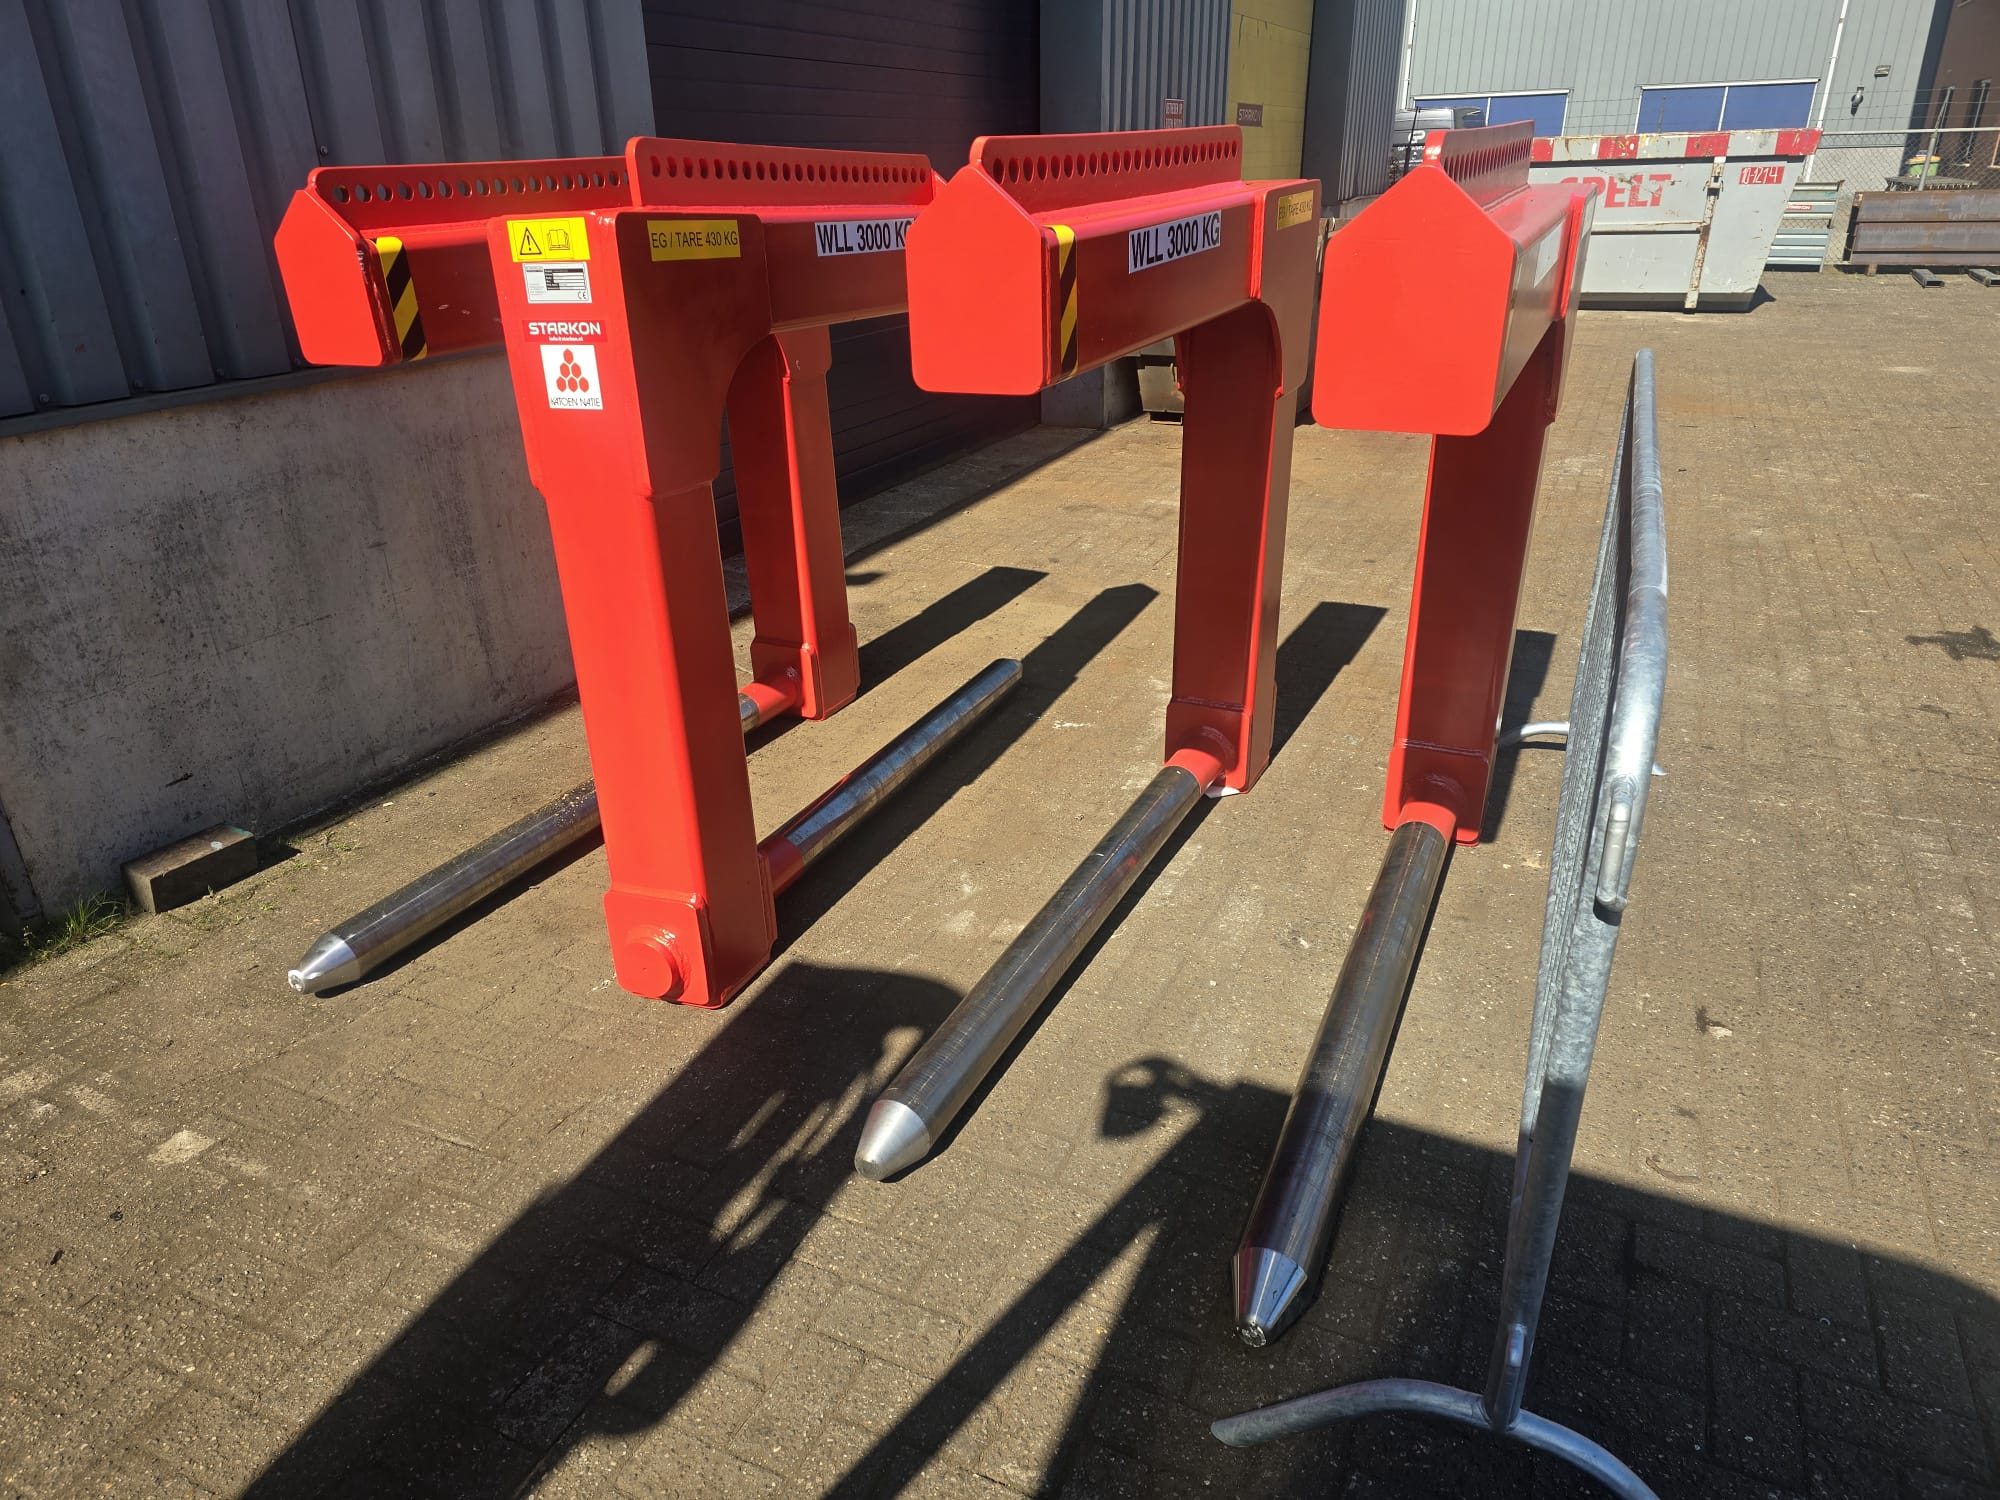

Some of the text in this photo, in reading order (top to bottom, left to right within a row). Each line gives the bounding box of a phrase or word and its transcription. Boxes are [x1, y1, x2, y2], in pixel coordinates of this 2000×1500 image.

[1560, 174, 1672, 208] PELT
[651, 232, 667, 248] EG
[676, 232, 703, 248] TARE
[705, 231, 721, 246] 430
[724, 230, 738, 246] KG
[817, 223, 854, 254] WLL
[857, 222, 891, 251] 3000
[1131, 212, 1220, 269] WLL 3000 KG
[528, 321, 601, 336] STARKON
[551, 397, 601, 407] KATOEN NATIE
